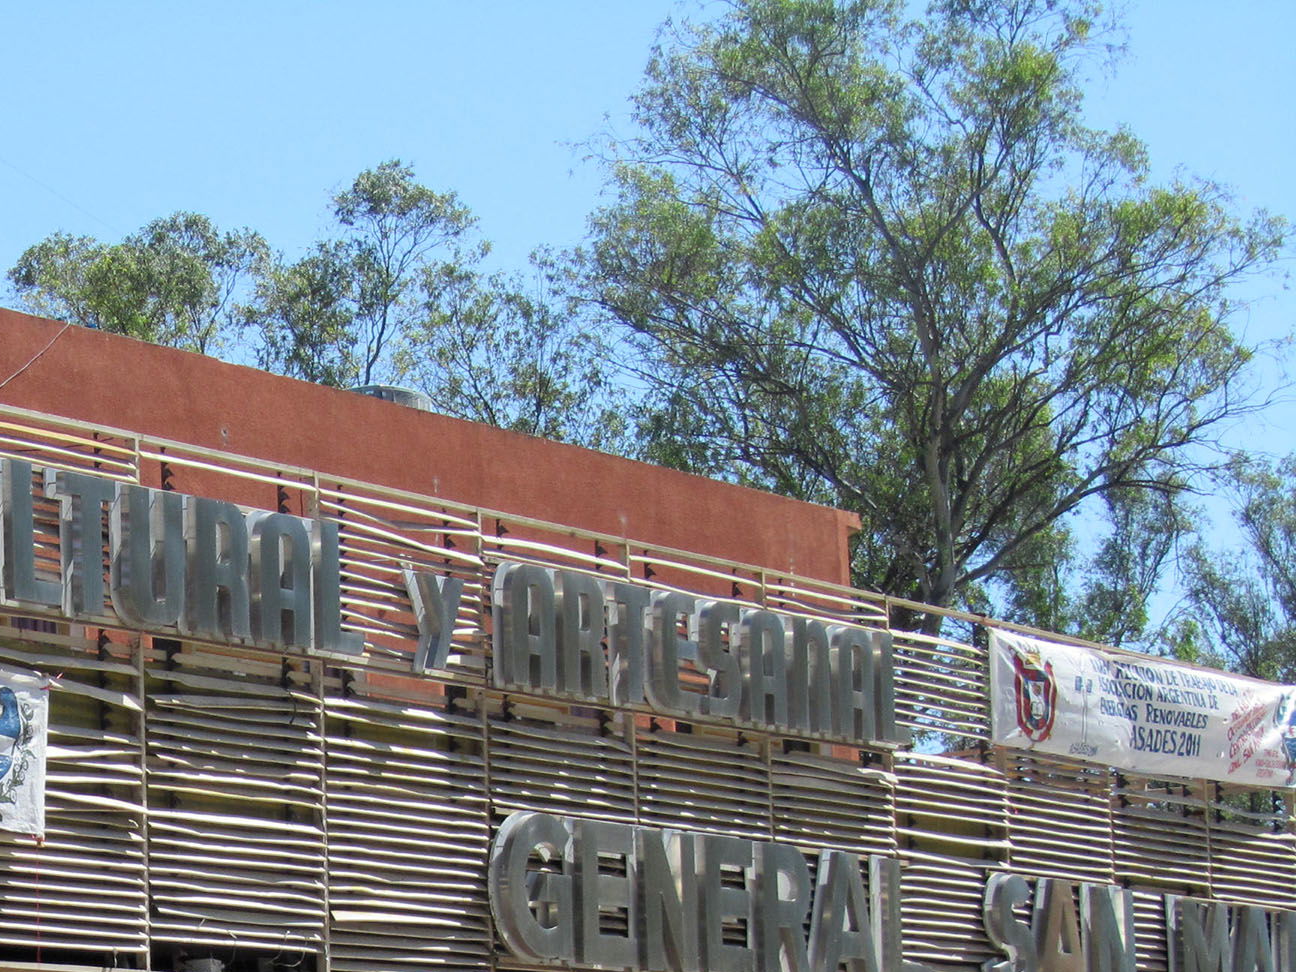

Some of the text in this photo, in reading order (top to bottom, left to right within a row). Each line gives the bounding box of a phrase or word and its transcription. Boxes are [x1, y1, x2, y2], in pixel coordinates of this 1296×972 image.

[402, 563, 464, 674] Y
[492, 562, 912, 747] ARTESANAL
[1156, 685, 1207, 709] ARGENTINA
[1208, 694, 1220, 710] DE
[1146, 705, 1209, 729] RENOVABLES
[1129, 725, 1178, 755] ASADES
[1177, 733, 1202, 757] 2011
